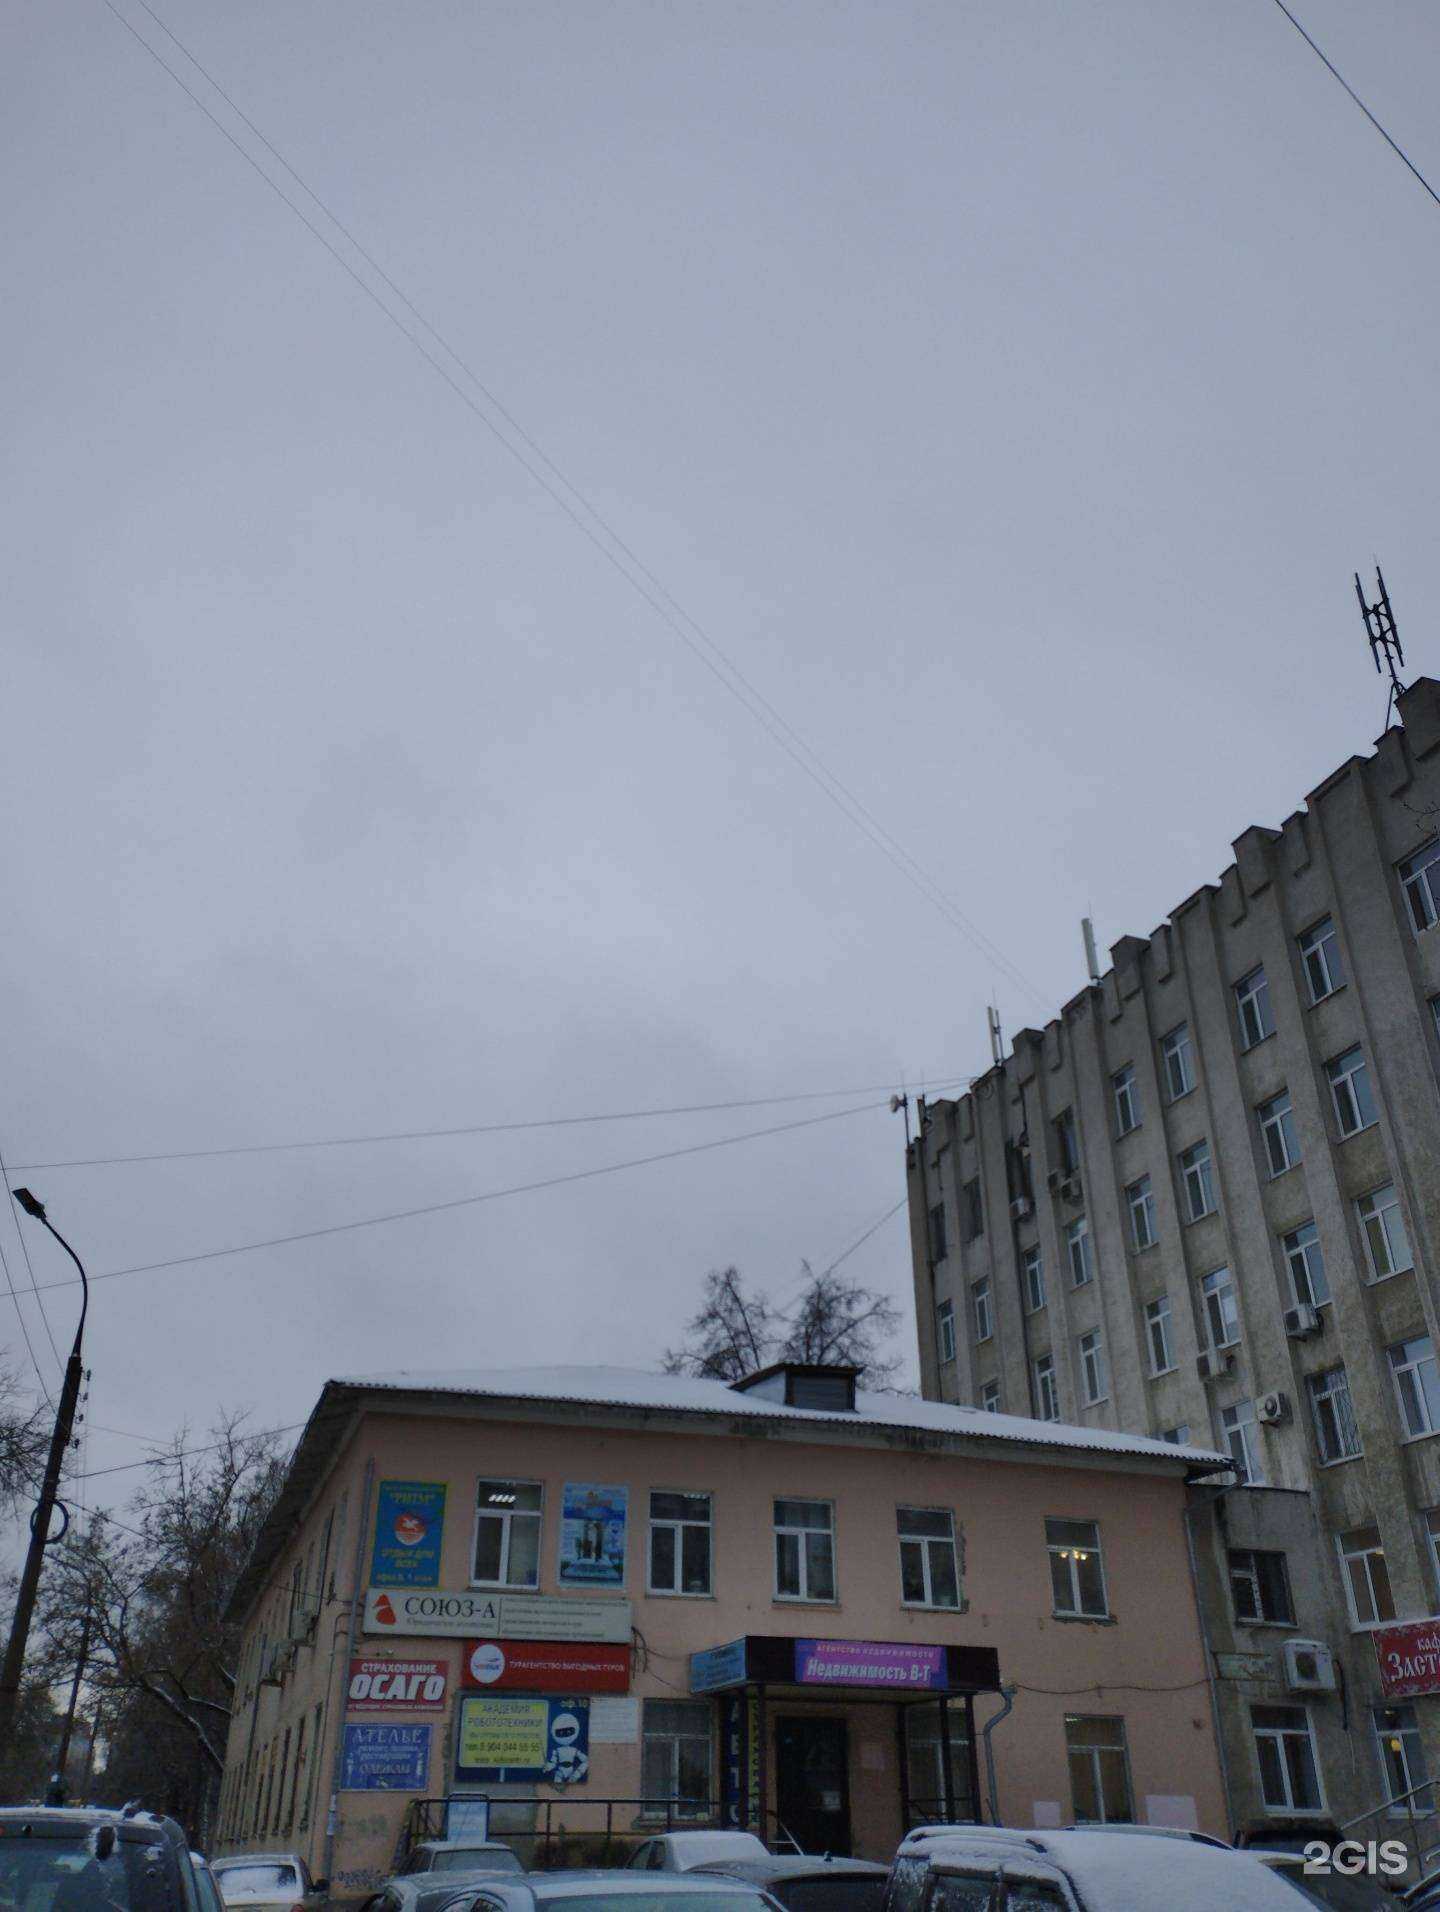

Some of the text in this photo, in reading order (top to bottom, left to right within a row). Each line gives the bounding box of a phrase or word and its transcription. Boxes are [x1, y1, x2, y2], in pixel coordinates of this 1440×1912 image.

[405, 1597, 496, 1618] СОЮЗ-А
[361, 1662, 437, 1674] СТРАХОВАНИЕ
[807, 1658, 908, 1681] Недвижимость
[349, 1673, 446, 1701] ОСАГО
[482, 1703, 530, 1715] АКАДЕМИЯ
[352, 1728, 422, 1744] АТЕЛЬЕ
